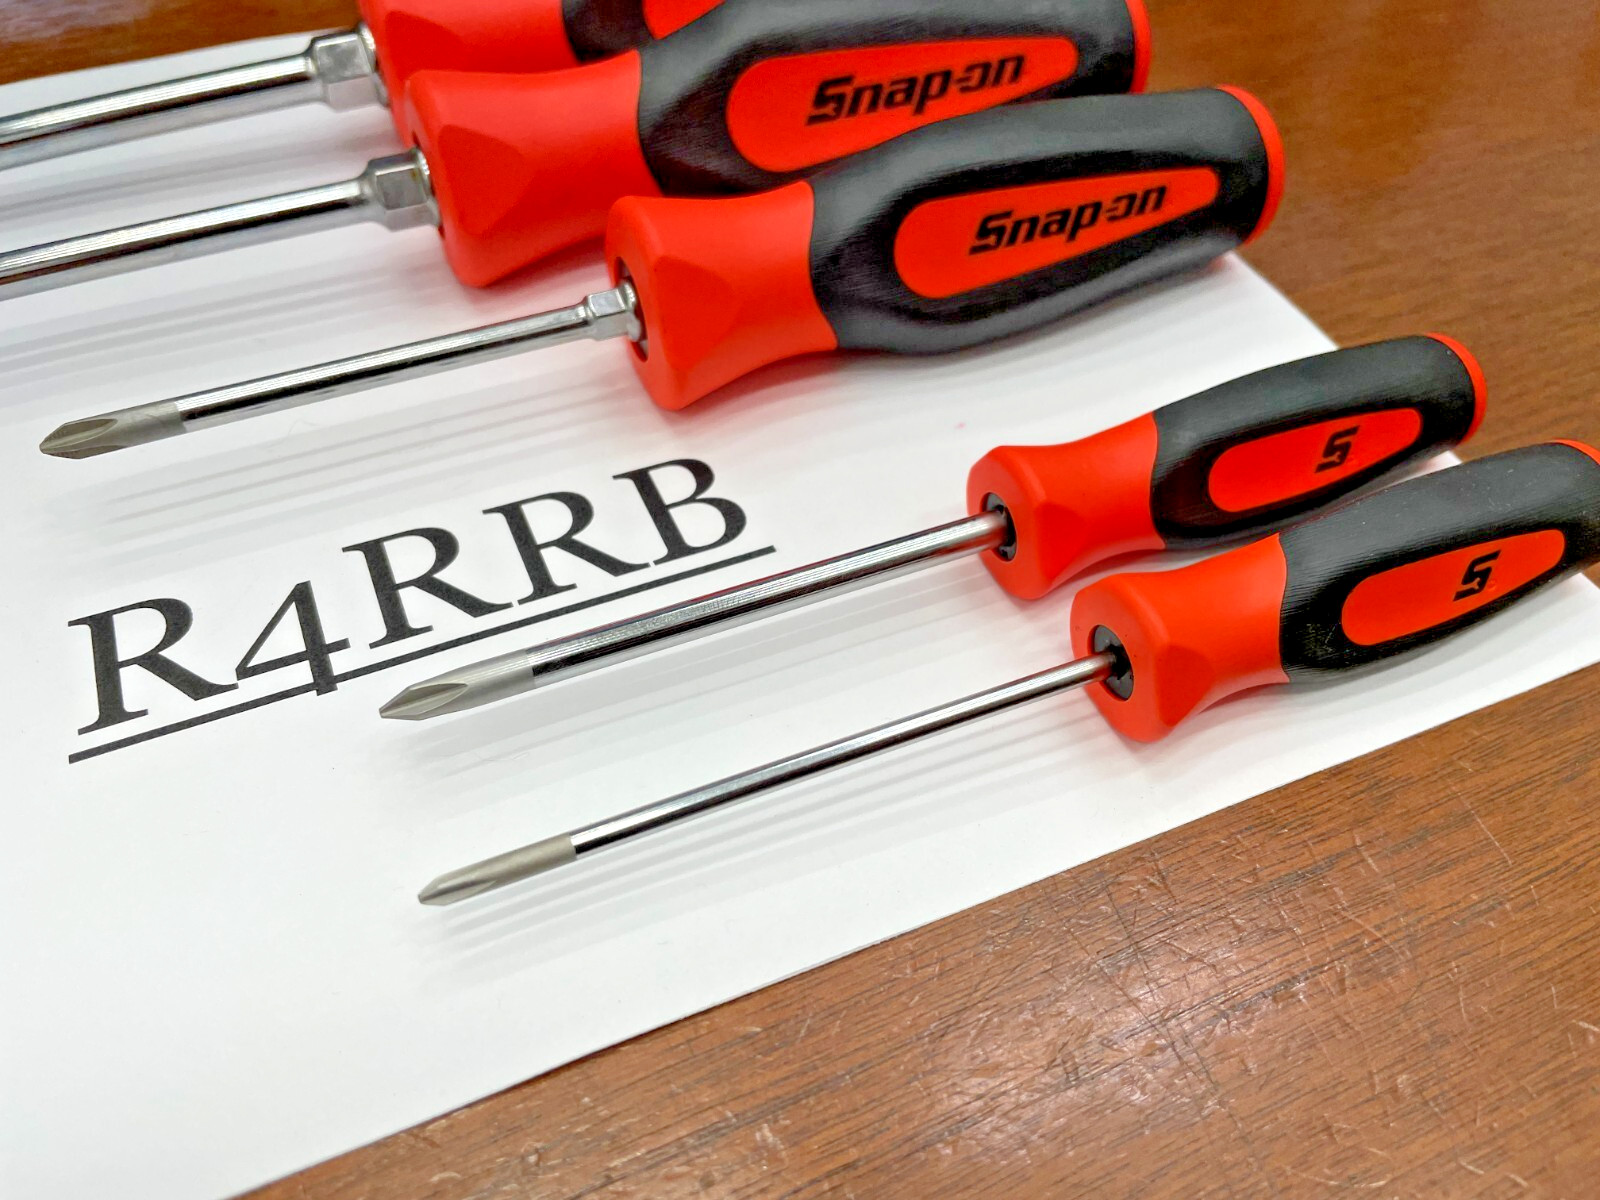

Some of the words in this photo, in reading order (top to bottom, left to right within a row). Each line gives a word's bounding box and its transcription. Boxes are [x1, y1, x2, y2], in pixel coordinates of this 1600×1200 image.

[806, 54, 1025, 126] Snap-on
[968, 185, 1168, 255] Snap-on
[1315, 425, 1359, 473] S
[68, 459, 746, 736] R4RRB
[1453, 549, 1501, 602] S
